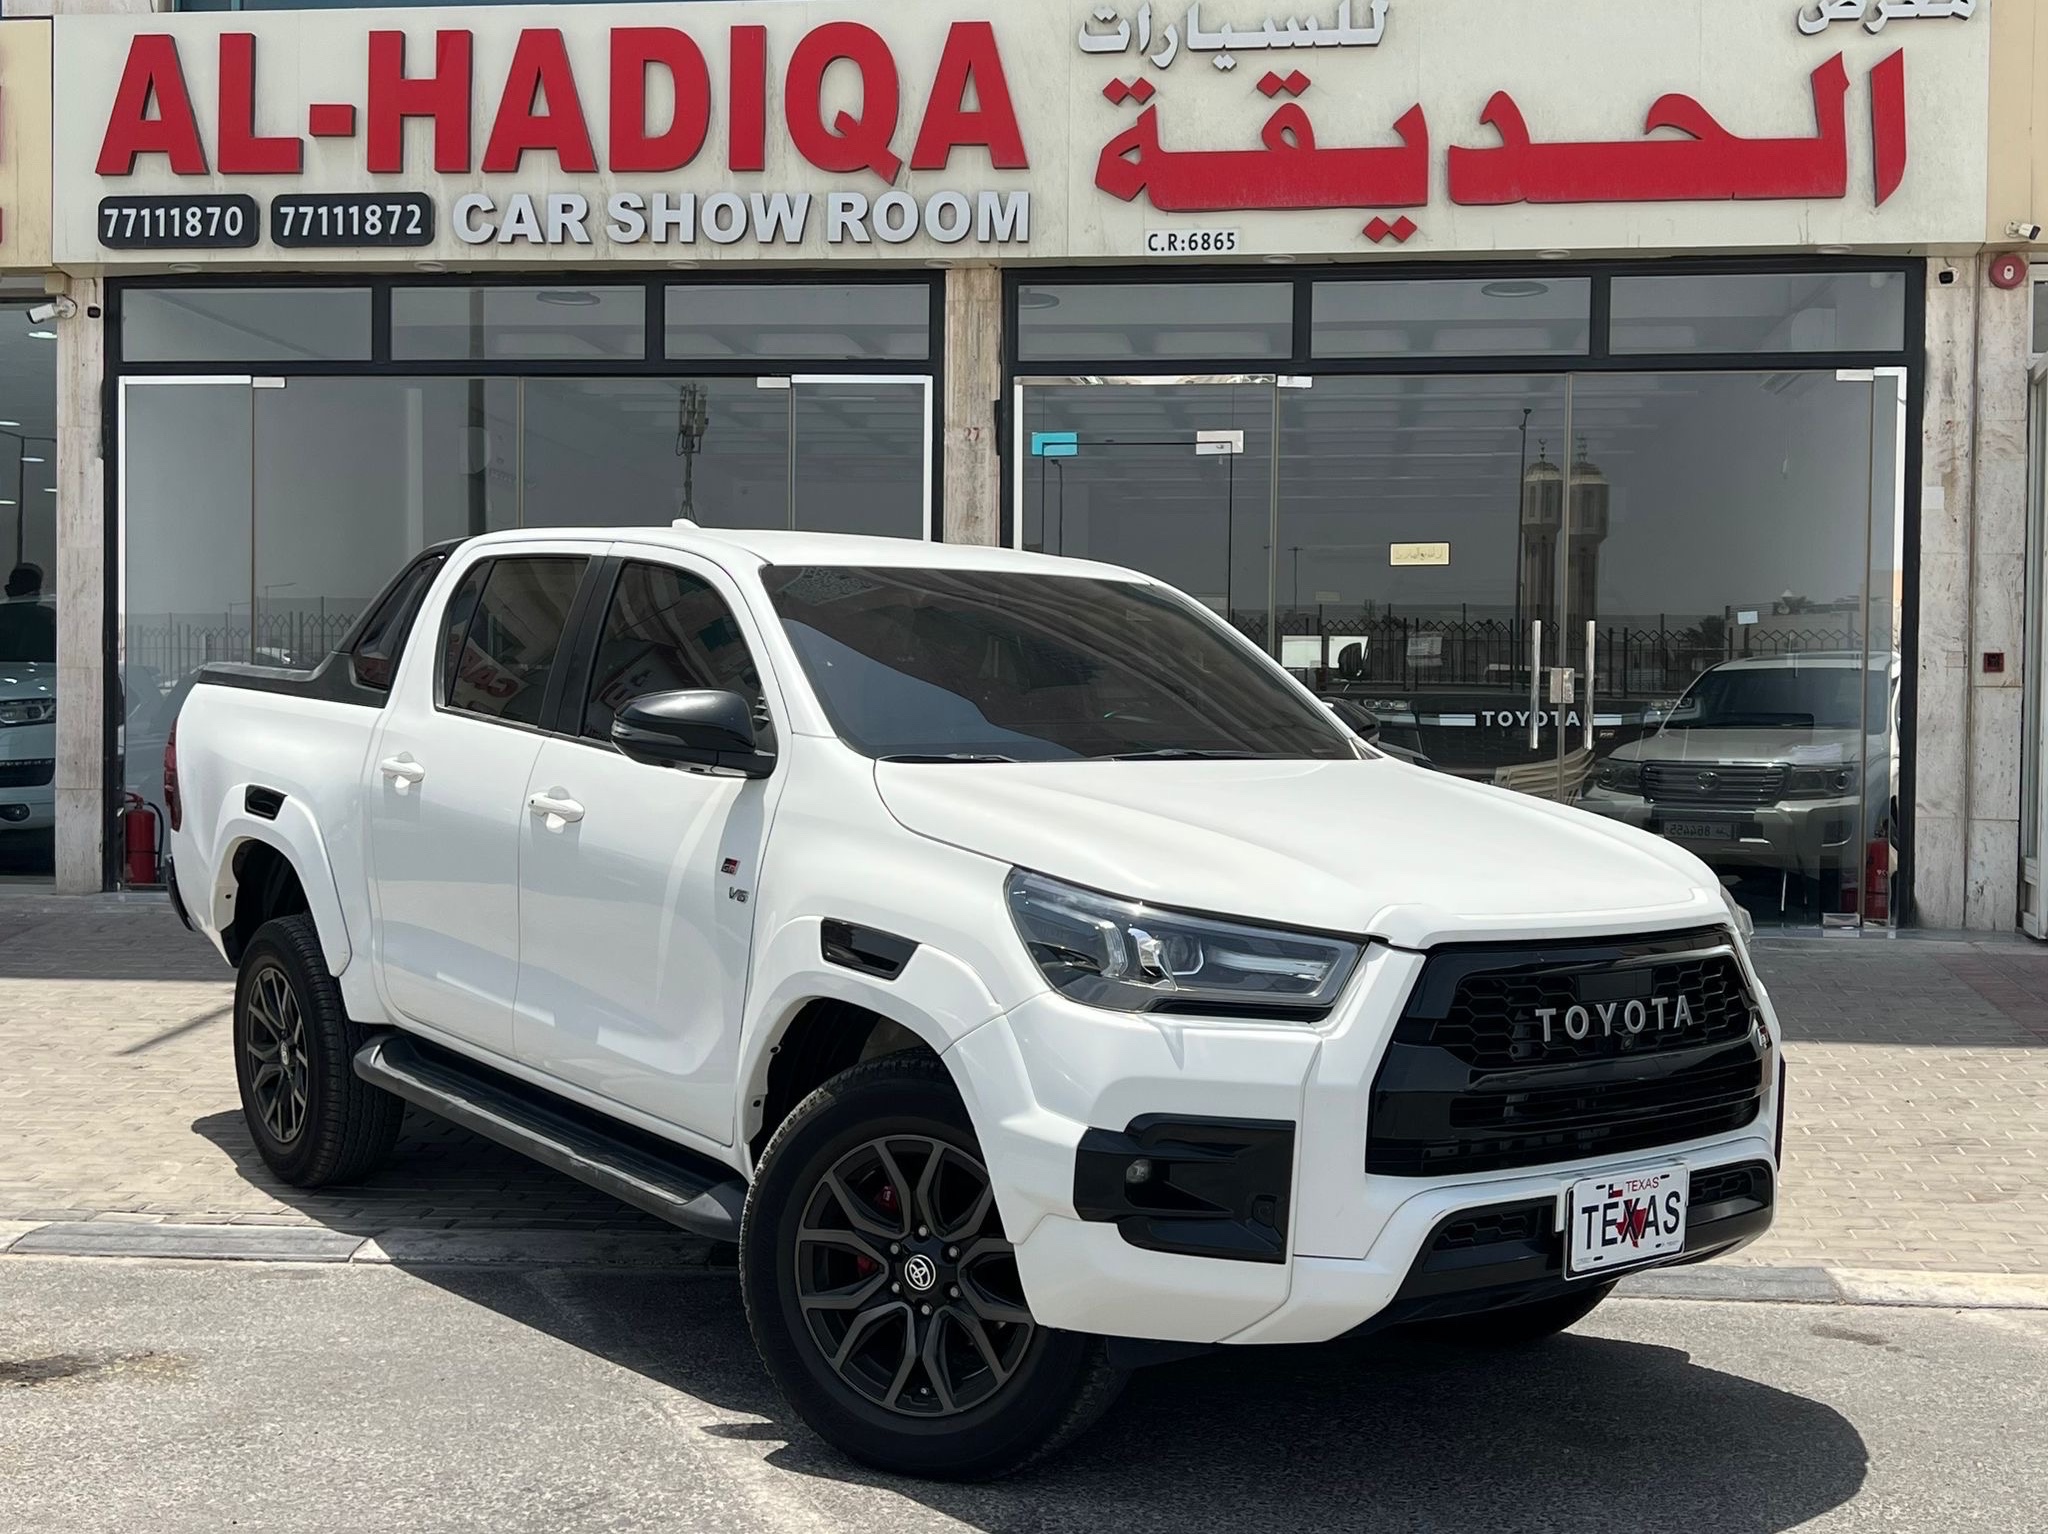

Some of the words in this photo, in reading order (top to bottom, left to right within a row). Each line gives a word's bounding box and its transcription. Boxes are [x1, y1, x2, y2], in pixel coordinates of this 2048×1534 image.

[1078, 0, 1389, 69] للسيارات
[95, 21, 1029, 185] AL-HADIQA
[1095, 47, 1907, 243] الحديقة
[103, 205, 244, 238] 77111870
[279, 204, 423, 237] 77111872
[452, 192, 591, 244] CAR
[606, 192, 811, 244] SHOW
[827, 190, 1031, 243] ROOM
[1148, 232, 1235, 252] C.R:6865
[1482, 711, 1581, 727] TOYOTA
[729, 886, 749, 903] V6
[1535, 995, 1694, 1042] TOYOTA
[1625, 1176, 1660, 1193] TEXAS
[1581, 1190, 1681, 1250] TEXAS
